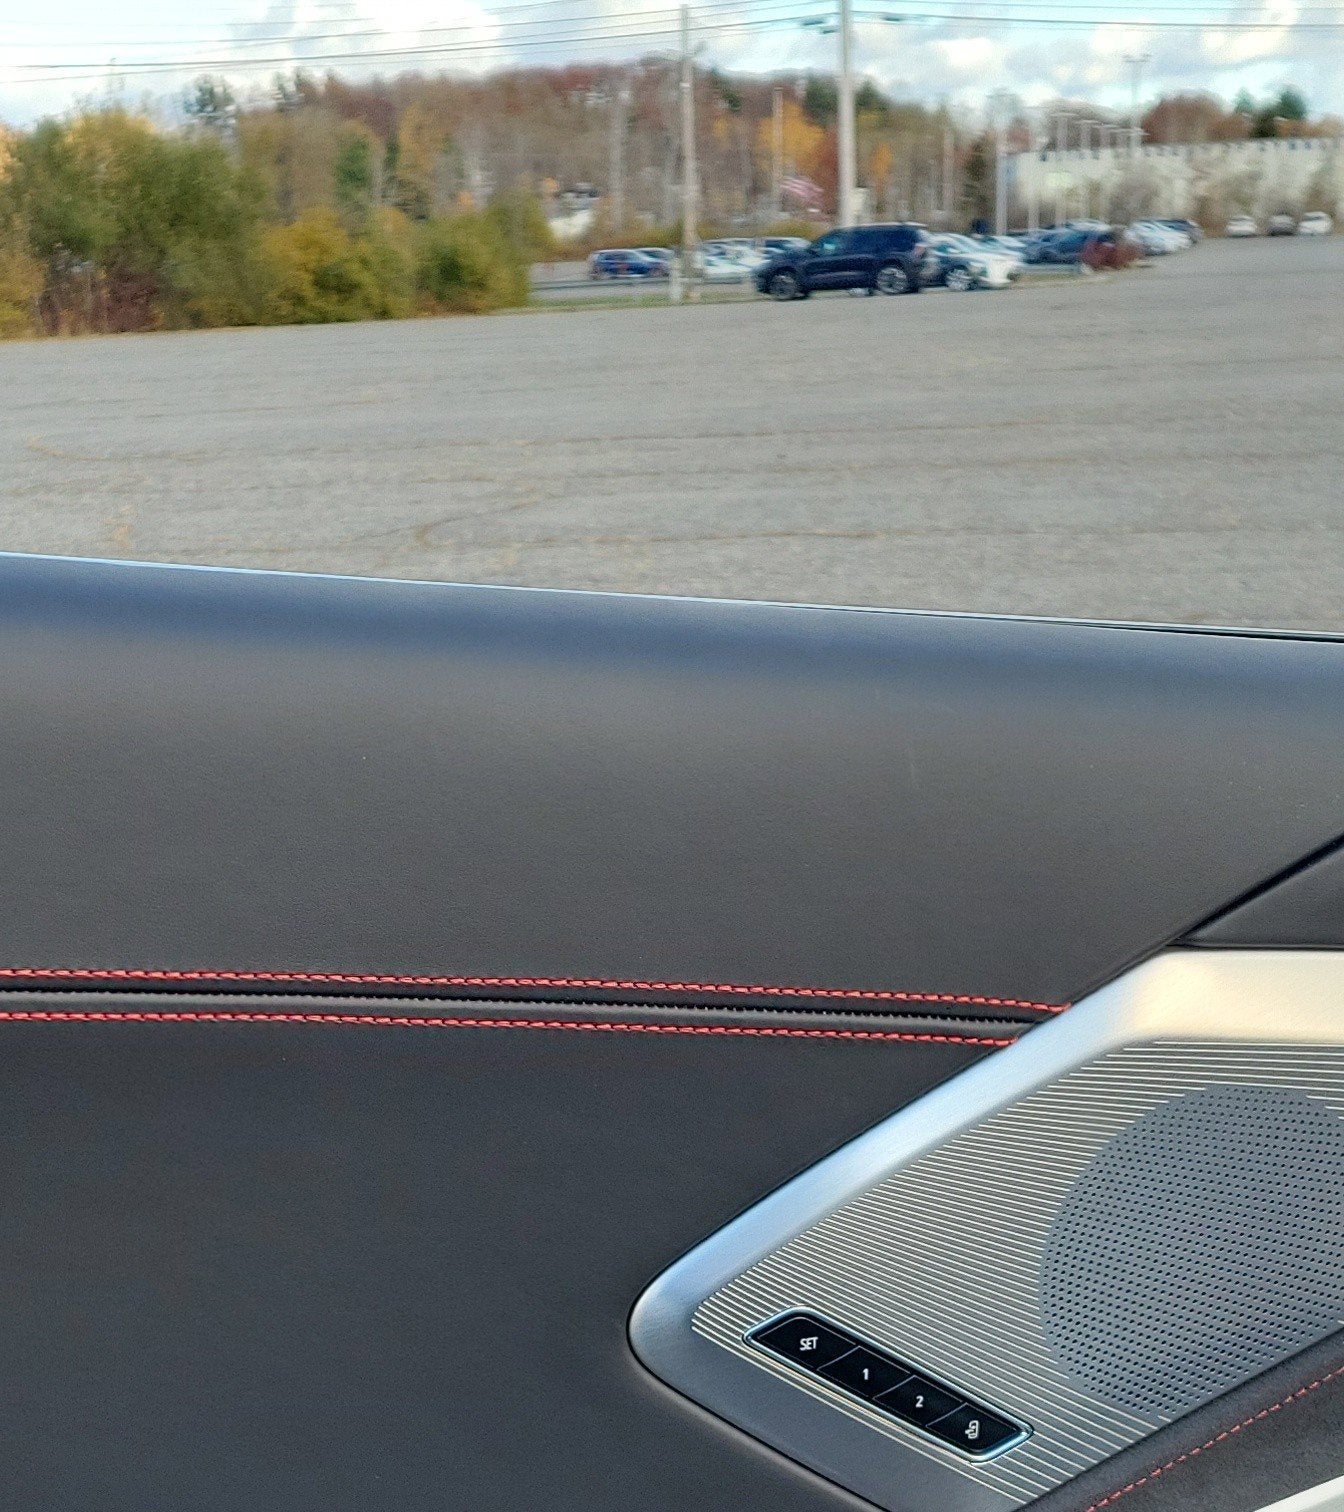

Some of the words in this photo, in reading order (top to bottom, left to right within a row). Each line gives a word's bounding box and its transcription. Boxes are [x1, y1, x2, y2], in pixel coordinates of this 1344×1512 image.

[799, 1336, 819, 1351] SET
[862, 1368, 870, 1381] 1
[915, 1395, 924, 1408] 2
